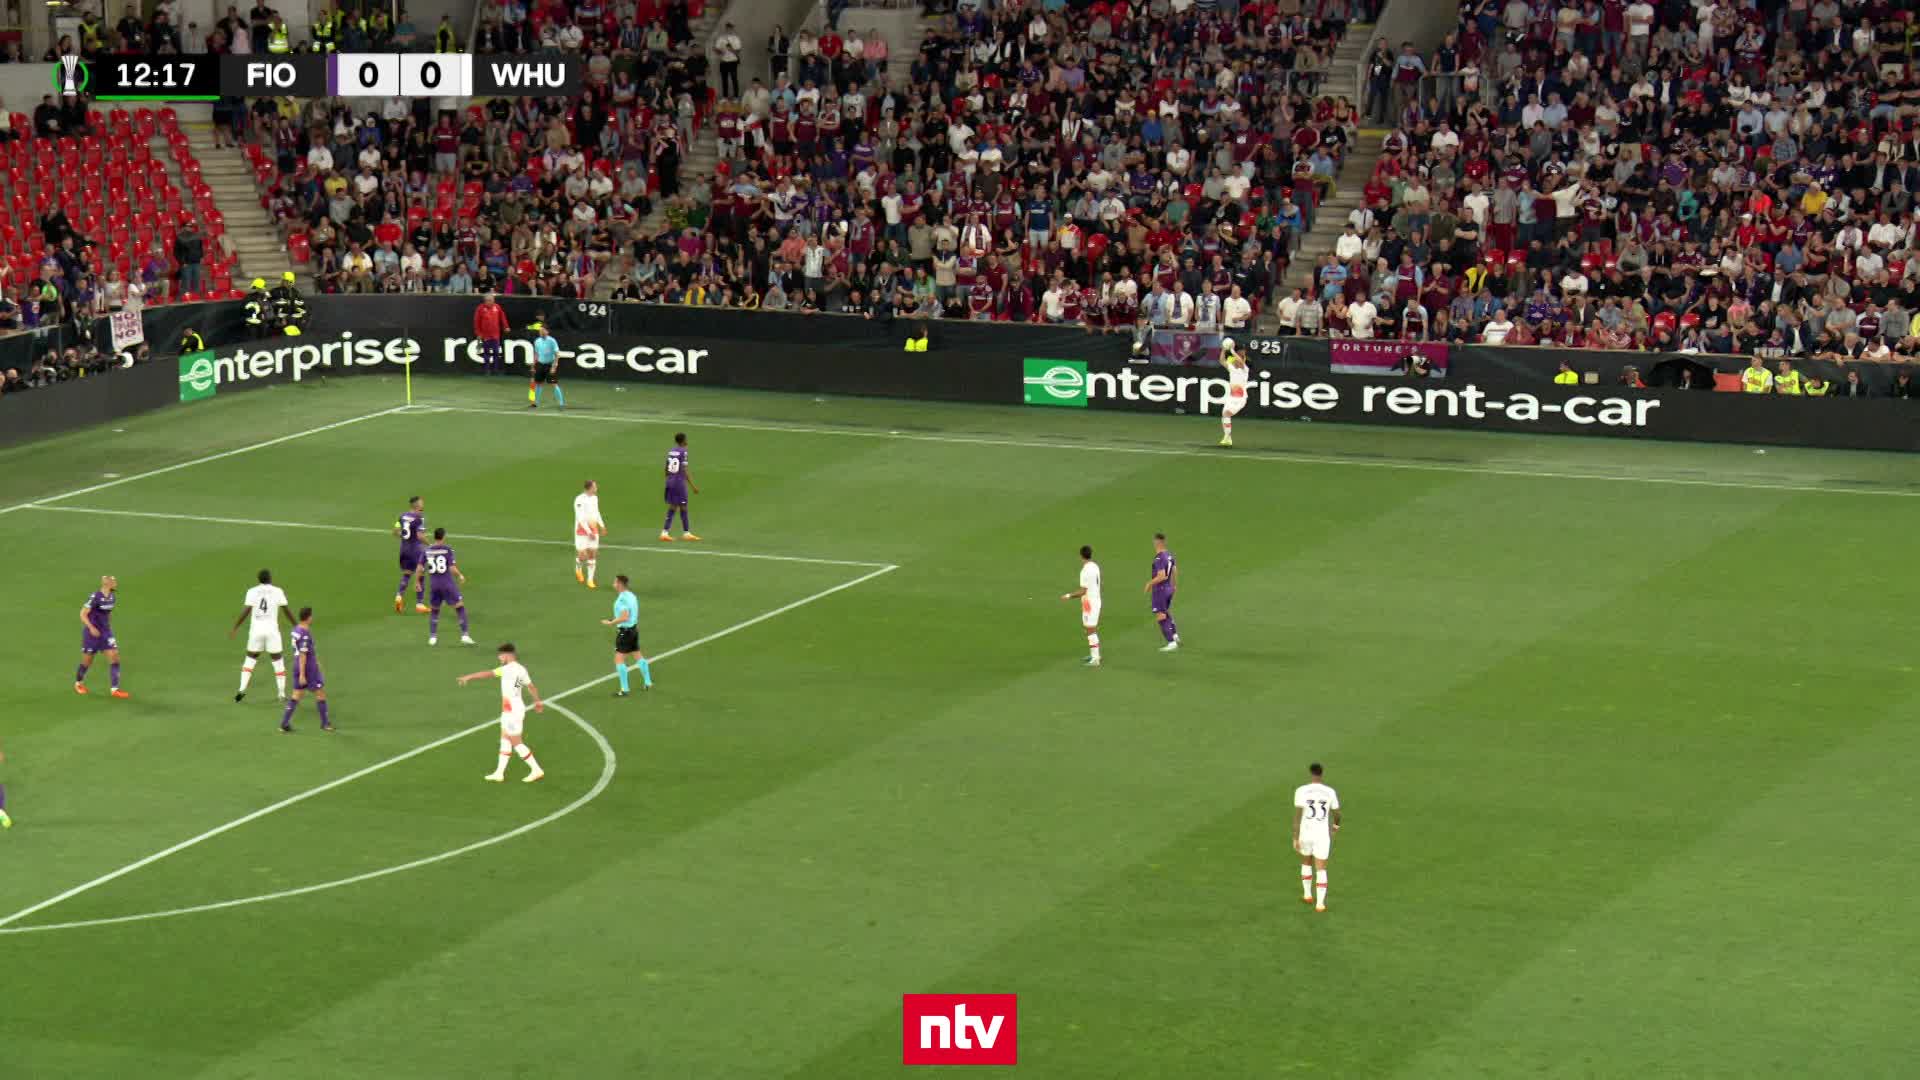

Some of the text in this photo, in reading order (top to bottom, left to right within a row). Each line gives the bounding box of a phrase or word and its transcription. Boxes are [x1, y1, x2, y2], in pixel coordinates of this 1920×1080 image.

[589, 303, 607, 316] 24
[1261, 341, 1280, 354] 25
[1332, 343, 1418, 354] FORTUNE'S
[180, 331, 708, 391] enterprise ren-a-car
[1363, 384, 1660, 426] rent-a-car
[427, 555, 448, 574] 38
[259, 598, 268, 613] 4
[1306, 799, 1327, 821] 33
